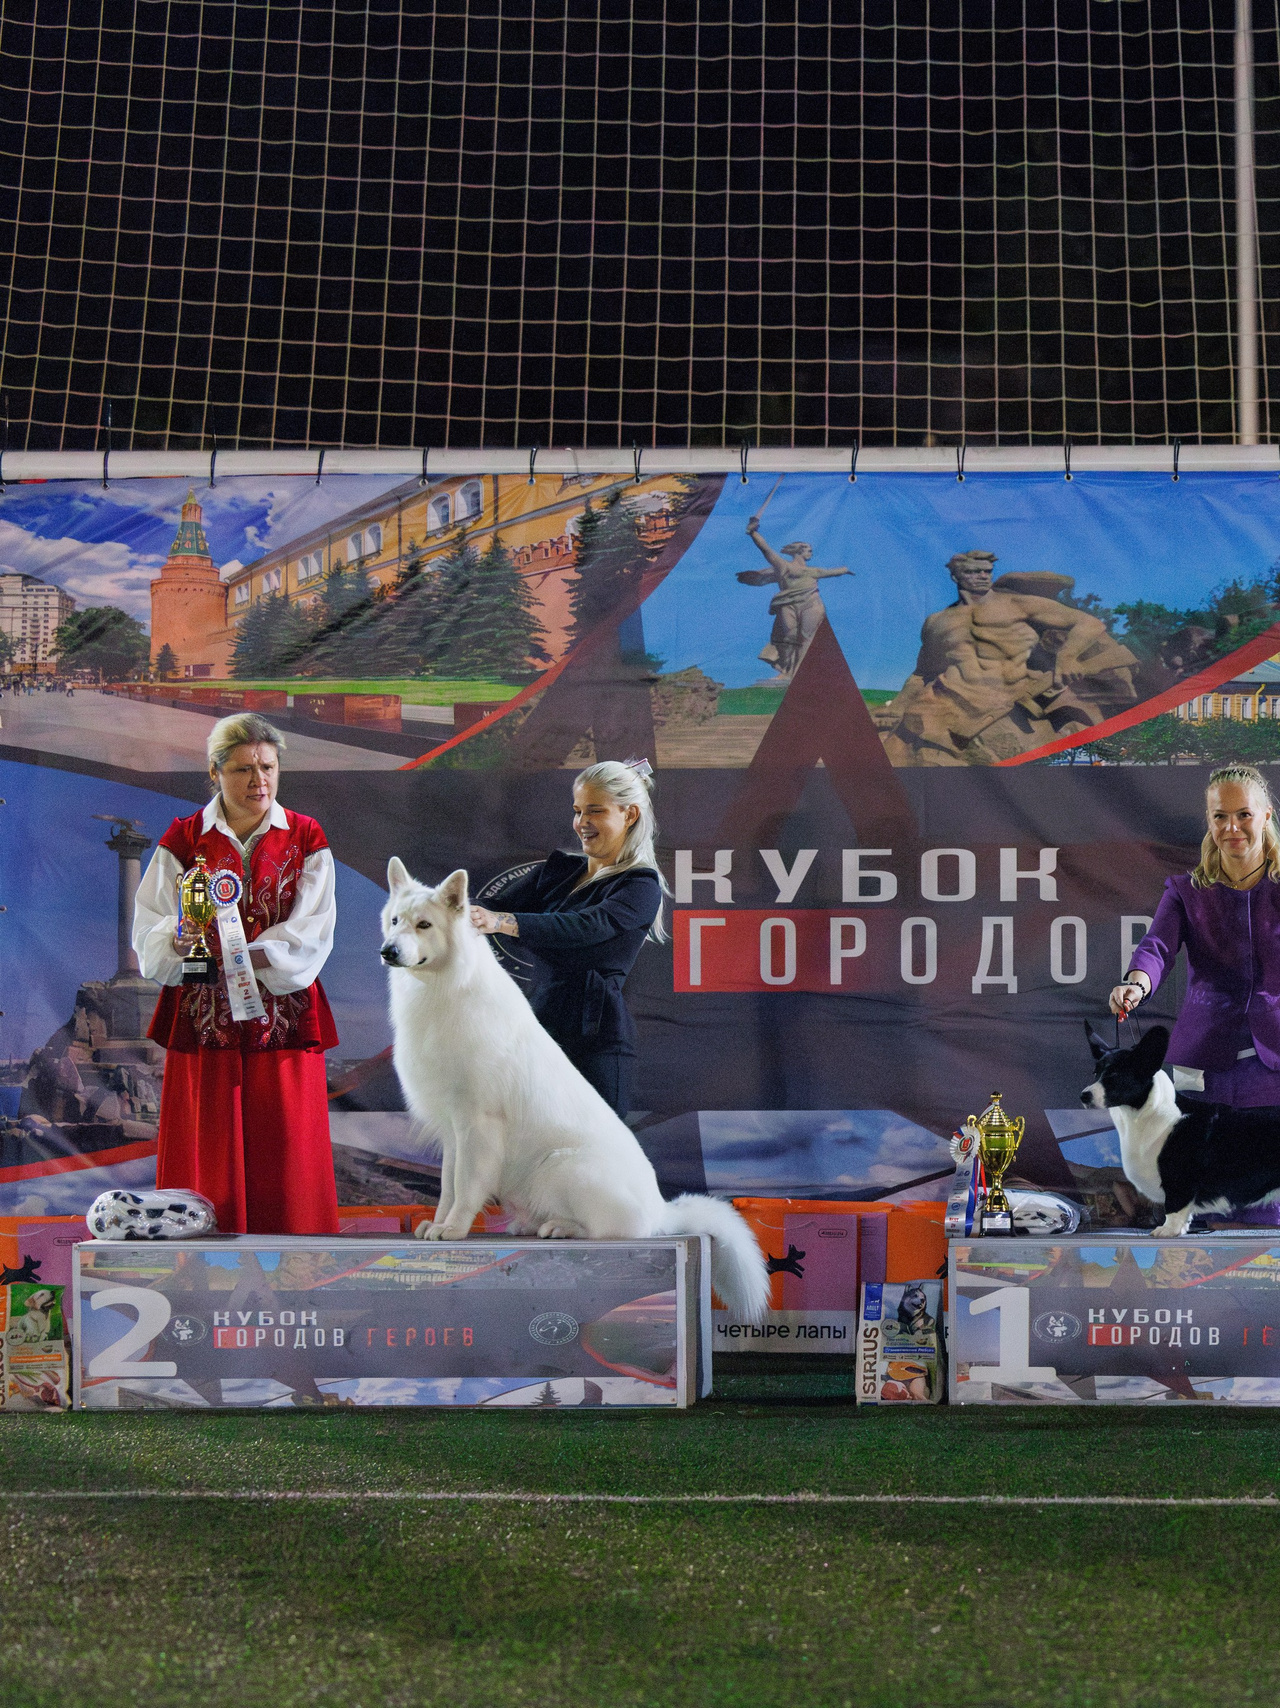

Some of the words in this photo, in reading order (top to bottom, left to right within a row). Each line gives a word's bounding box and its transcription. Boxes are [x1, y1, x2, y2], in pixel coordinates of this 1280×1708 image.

[483, 864, 538, 899] ЕДЕРАЦИ
[675, 847, 1060, 903] КУБОК
[213, 1310, 317, 1326] КУБОК
[1088, 1308, 1193, 1324] КУБОК
[89, 1287, 178, 1378] 2
[217, 1328, 344, 1349] ГОРОДОВ
[717, 1323, 790, 1338] четыре
[795, 1324, 847, 1339] лапы
[969, 1286, 1057, 1383] 1
[1092, 1326, 1220, 1348] ГОРОДОВ
[862, 1326, 879, 1395] SIRIUS
